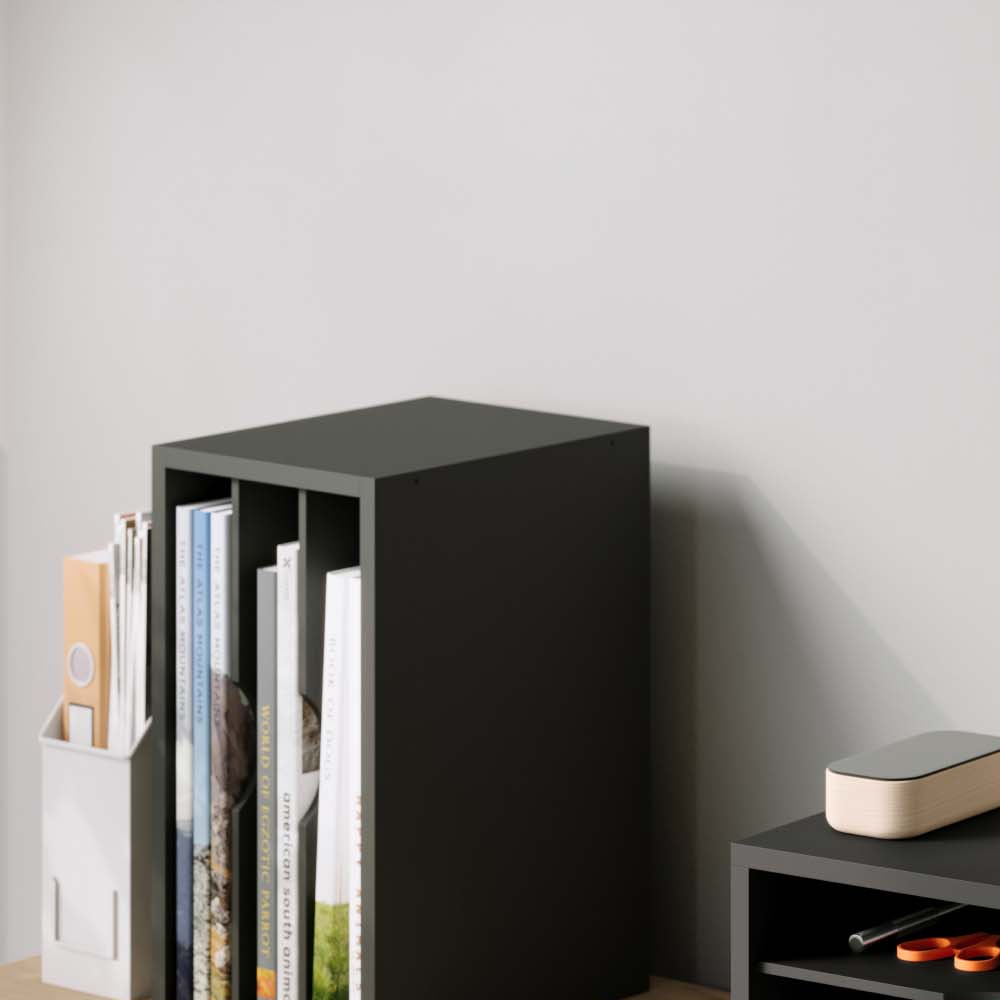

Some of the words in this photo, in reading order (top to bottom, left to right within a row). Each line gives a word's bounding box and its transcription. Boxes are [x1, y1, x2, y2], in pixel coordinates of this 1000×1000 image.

[196, 543, 204, 569] THE
[178, 578, 186, 625] ATLAS
[196, 578, 204, 627] ATLAS
[178, 631, 187, 721] MOUNTAINS
[196, 633, 204, 724] MOUNTAINS
[261, 704, 271, 769] WORLD
[261, 774, 271, 798] OF
[261, 805, 271, 881] EGZOTIC
[282, 792, 292, 882] american
[261, 889, 271, 957] PARROT
[282, 888, 292, 940] south
